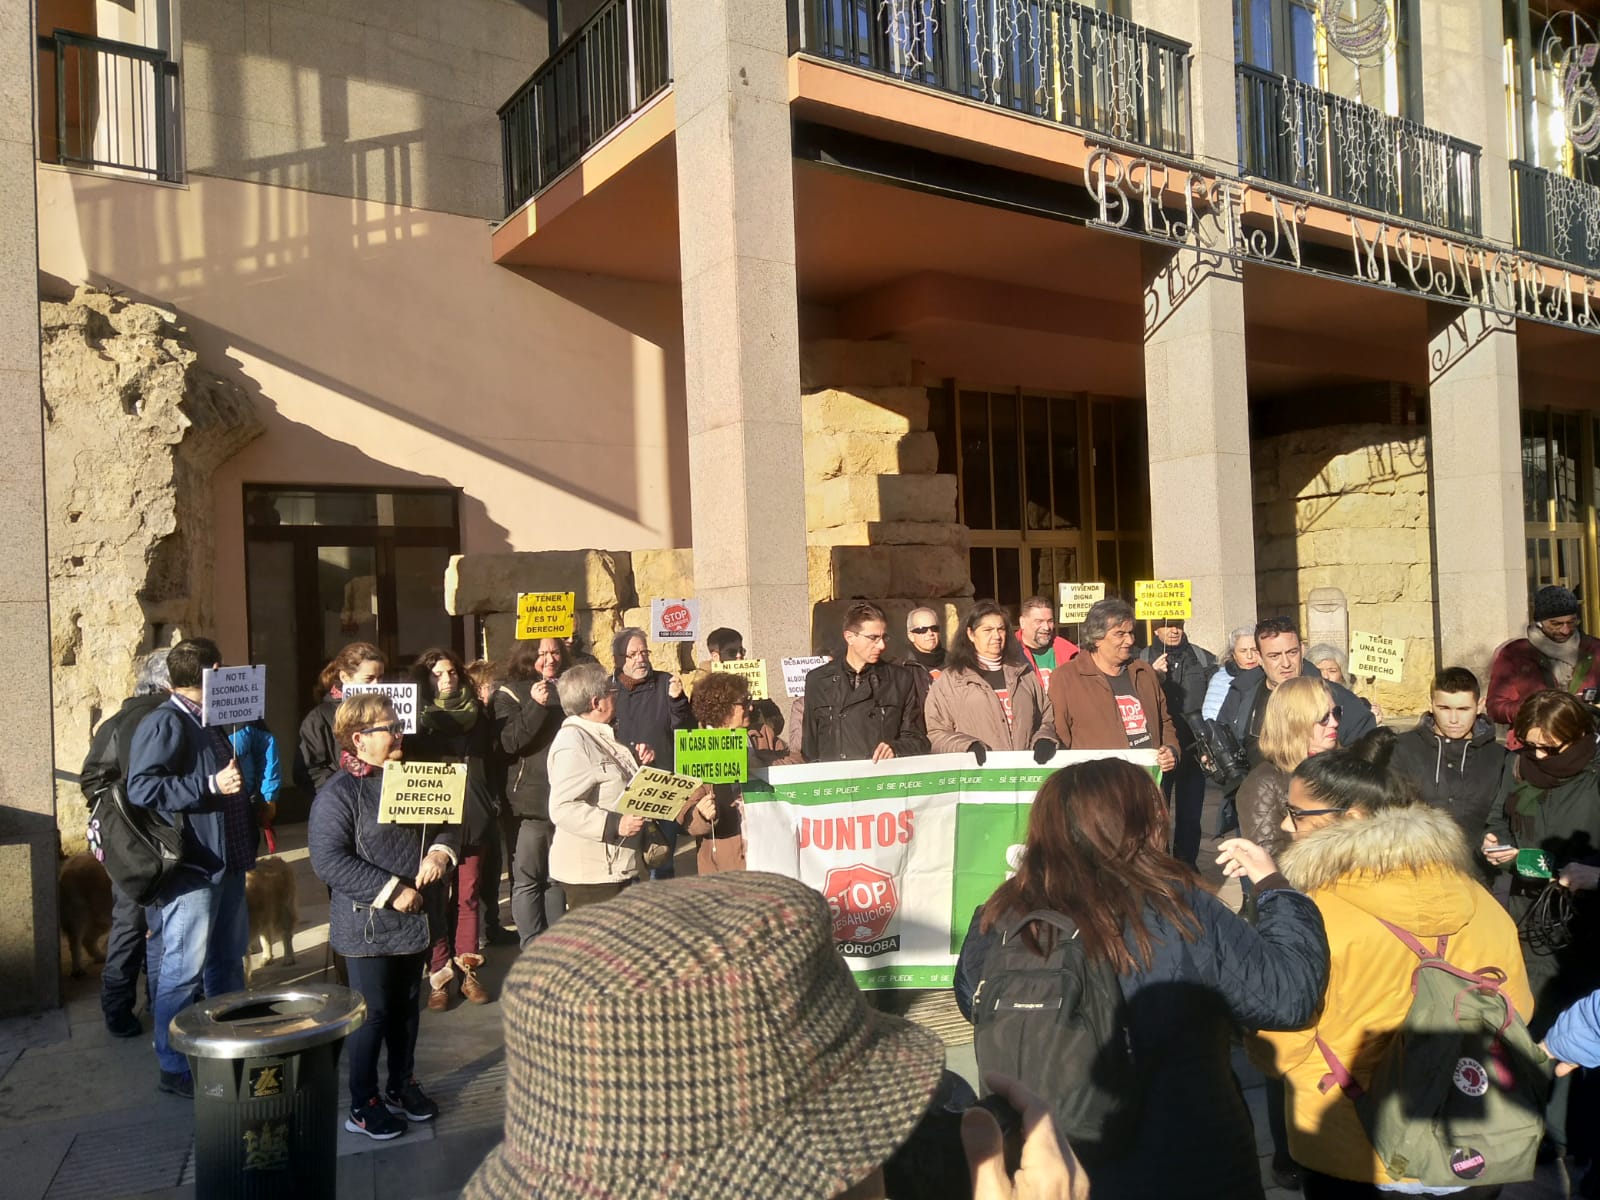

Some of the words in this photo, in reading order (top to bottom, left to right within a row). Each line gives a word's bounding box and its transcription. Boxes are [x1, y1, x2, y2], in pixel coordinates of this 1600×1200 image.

[526, 605, 543, 613] UNA
[535, 615, 545, 623] ES
[663, 609, 687, 624] STOP
[526, 625, 565, 633] DERECHO
[1369, 635, 1393, 645] TENER
[1359, 644, 1375, 652] UNA
[1377, 647, 1397, 656] CASA
[1366, 654, 1376, 662] ES
[1378, 656, 1388, 664] TU
[1358, 663, 1394, 675] DERECHO
[226, 672, 236, 681] NO
[237, 672, 246, 680] TE
[211, 684, 249, 696] ESCONDAS,
[251, 683, 259, 691] EL
[345, 687, 363, 698] SIN
[366, 686, 412, 699] TRABAJO
[212, 697, 249, 707] PROBLEMA
[250, 695, 258, 704] ES
[218, 711, 227, 720] DE
[229, 709, 252, 719] TODOS
[1118, 703, 1142, 717] TOP
[680, 736, 687, 751] NI
[689, 736, 707, 751] CASA
[708, 735, 720, 751] SIN
[721, 735, 743, 750] GENTE
[402, 765, 457, 775] VIVIENDA
[682, 763, 690, 776] NI
[691, 762, 714, 778] GENTE
[715, 762, 722, 777] SI
[723, 761, 741, 777] CASA
[407, 778, 444, 789] DIGNA
[644, 772, 696, 790] JUNTOS
[824, 788, 833, 796] SE
[835, 786, 861, 796] PUEDE
[886, 782, 896, 790] SE
[899, 780, 923, 789] PUEDE
[948, 777, 957, 785] SE
[959, 776, 984, 784] PUEDE
[1009, 776, 1018, 784] SE
[1019, 775, 1043, 783] PUEDE
[395, 792, 452, 803] DERECHO
[659, 790, 678, 801] SE
[388, 805, 456, 816] UNIVERSAL
[626, 798, 673, 815] PUEDE!
[800, 809, 915, 850] JUNTOS
[828, 880, 887, 919] STOP
[832, 901, 892, 933] DESAHUCIOS
[889, 974, 915, 982] PUEDE
